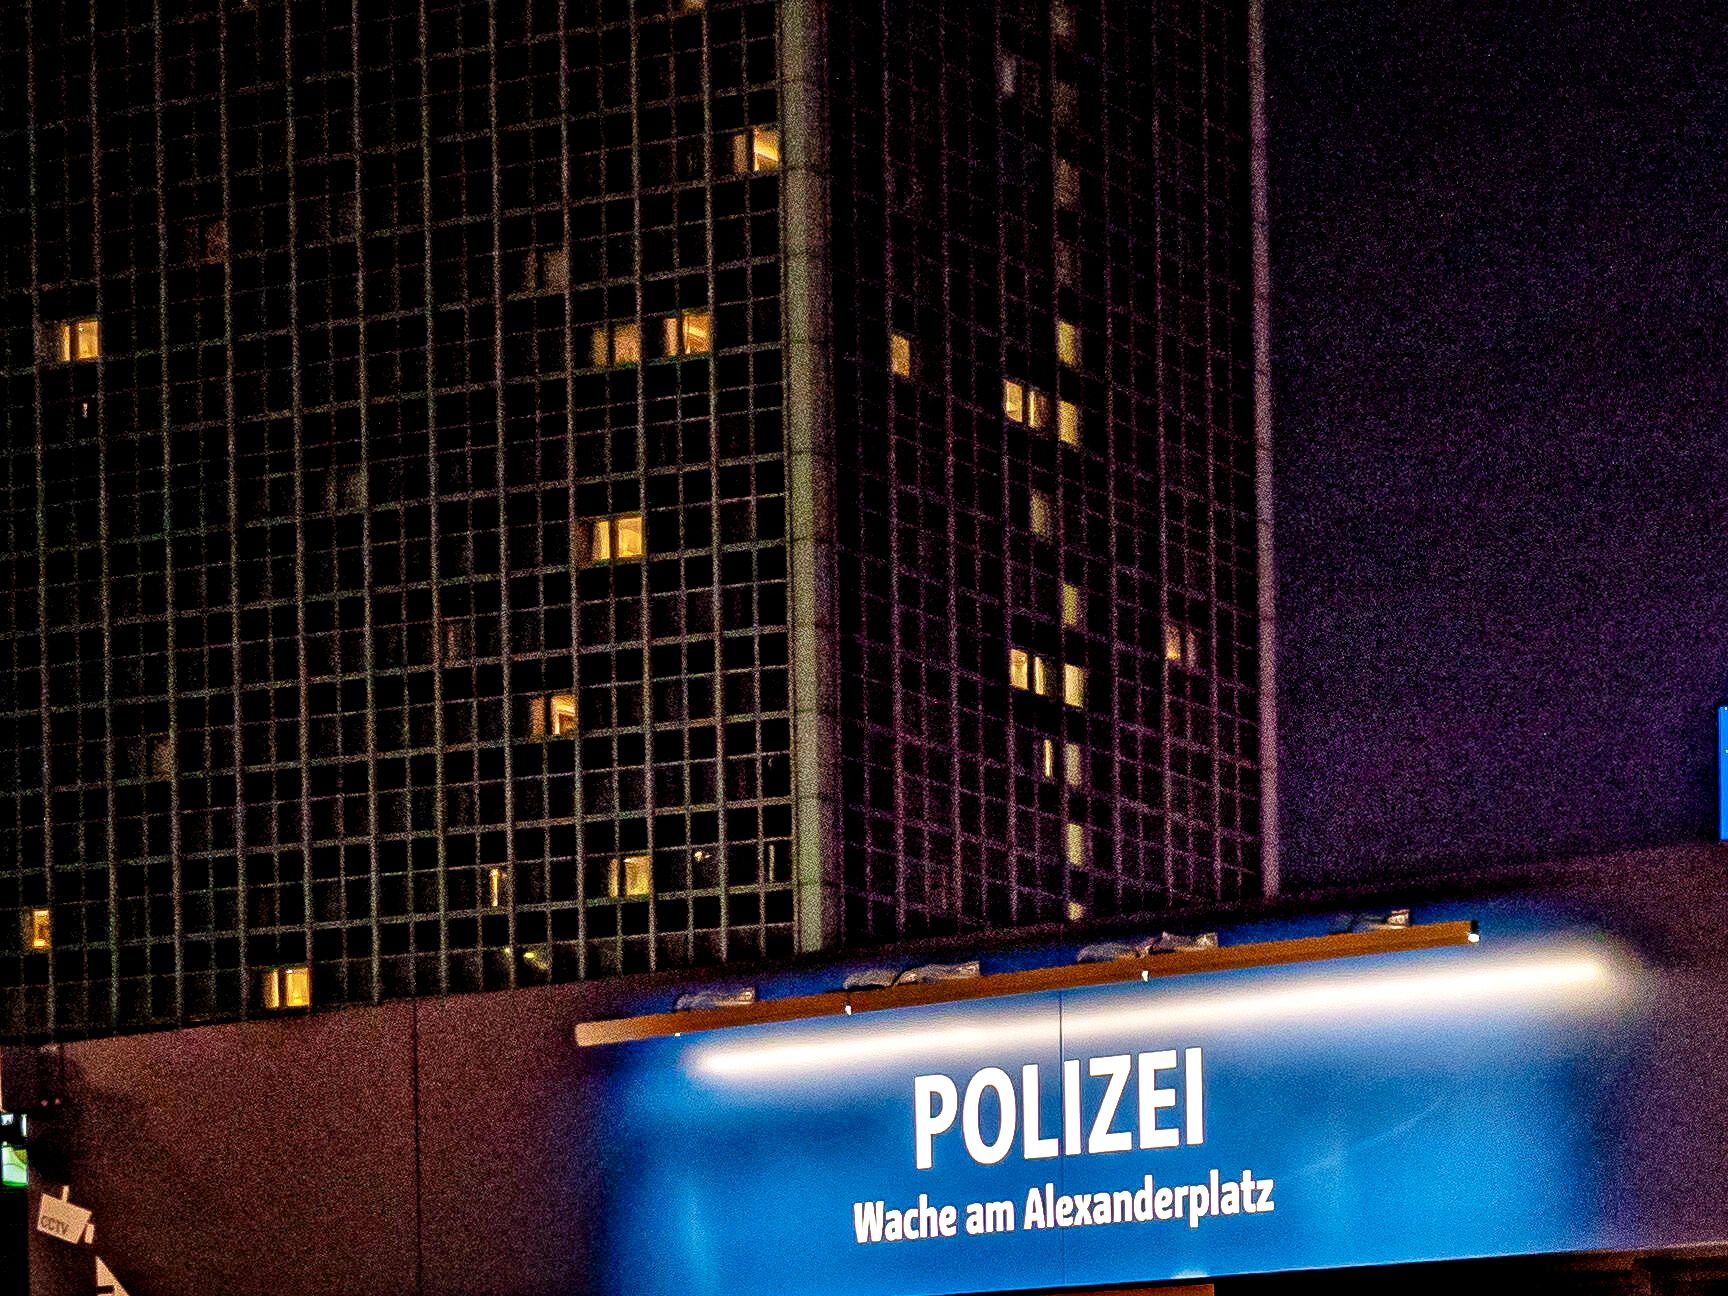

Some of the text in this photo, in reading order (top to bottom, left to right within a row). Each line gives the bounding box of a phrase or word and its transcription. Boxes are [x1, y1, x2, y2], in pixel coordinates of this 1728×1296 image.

[913, 1046, 1205, 1170] POLIZEI
[852, 1168, 1275, 1244] Wache am Alexanderplatz
